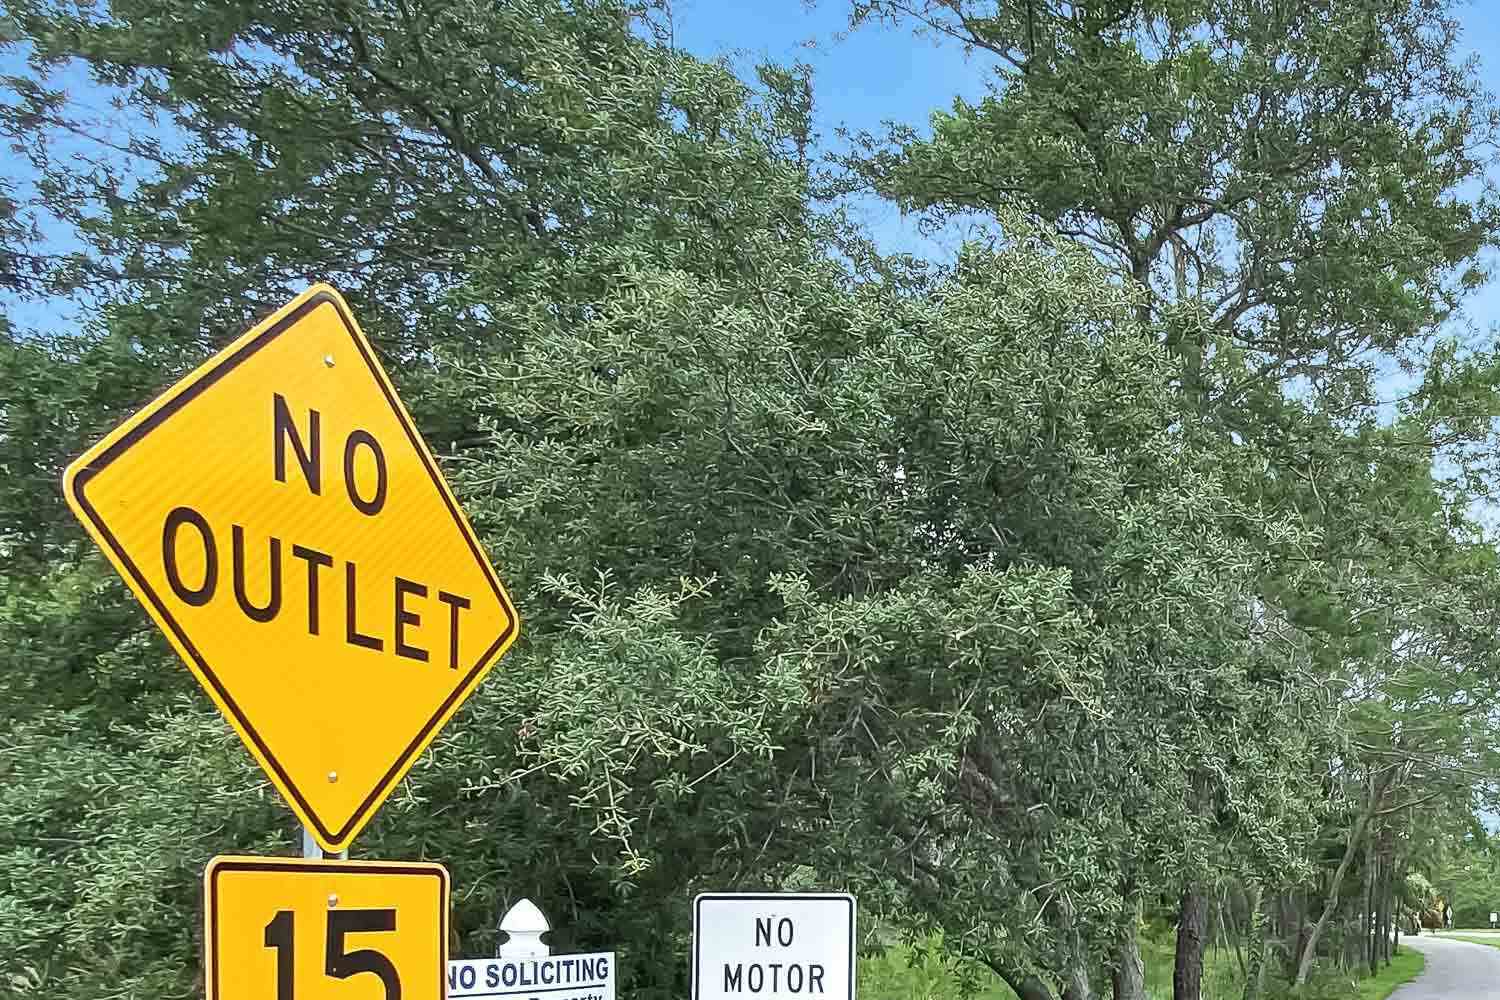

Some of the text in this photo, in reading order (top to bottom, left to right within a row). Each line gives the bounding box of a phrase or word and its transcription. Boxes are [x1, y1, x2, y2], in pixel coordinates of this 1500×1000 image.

[274, 392, 388, 516] NO
[162, 506, 471, 670] OUTLET
[754, 917, 794, 948] NO
[485, 957, 609, 988] SOLICITING
[722, 963, 825, 993] MOTOR
